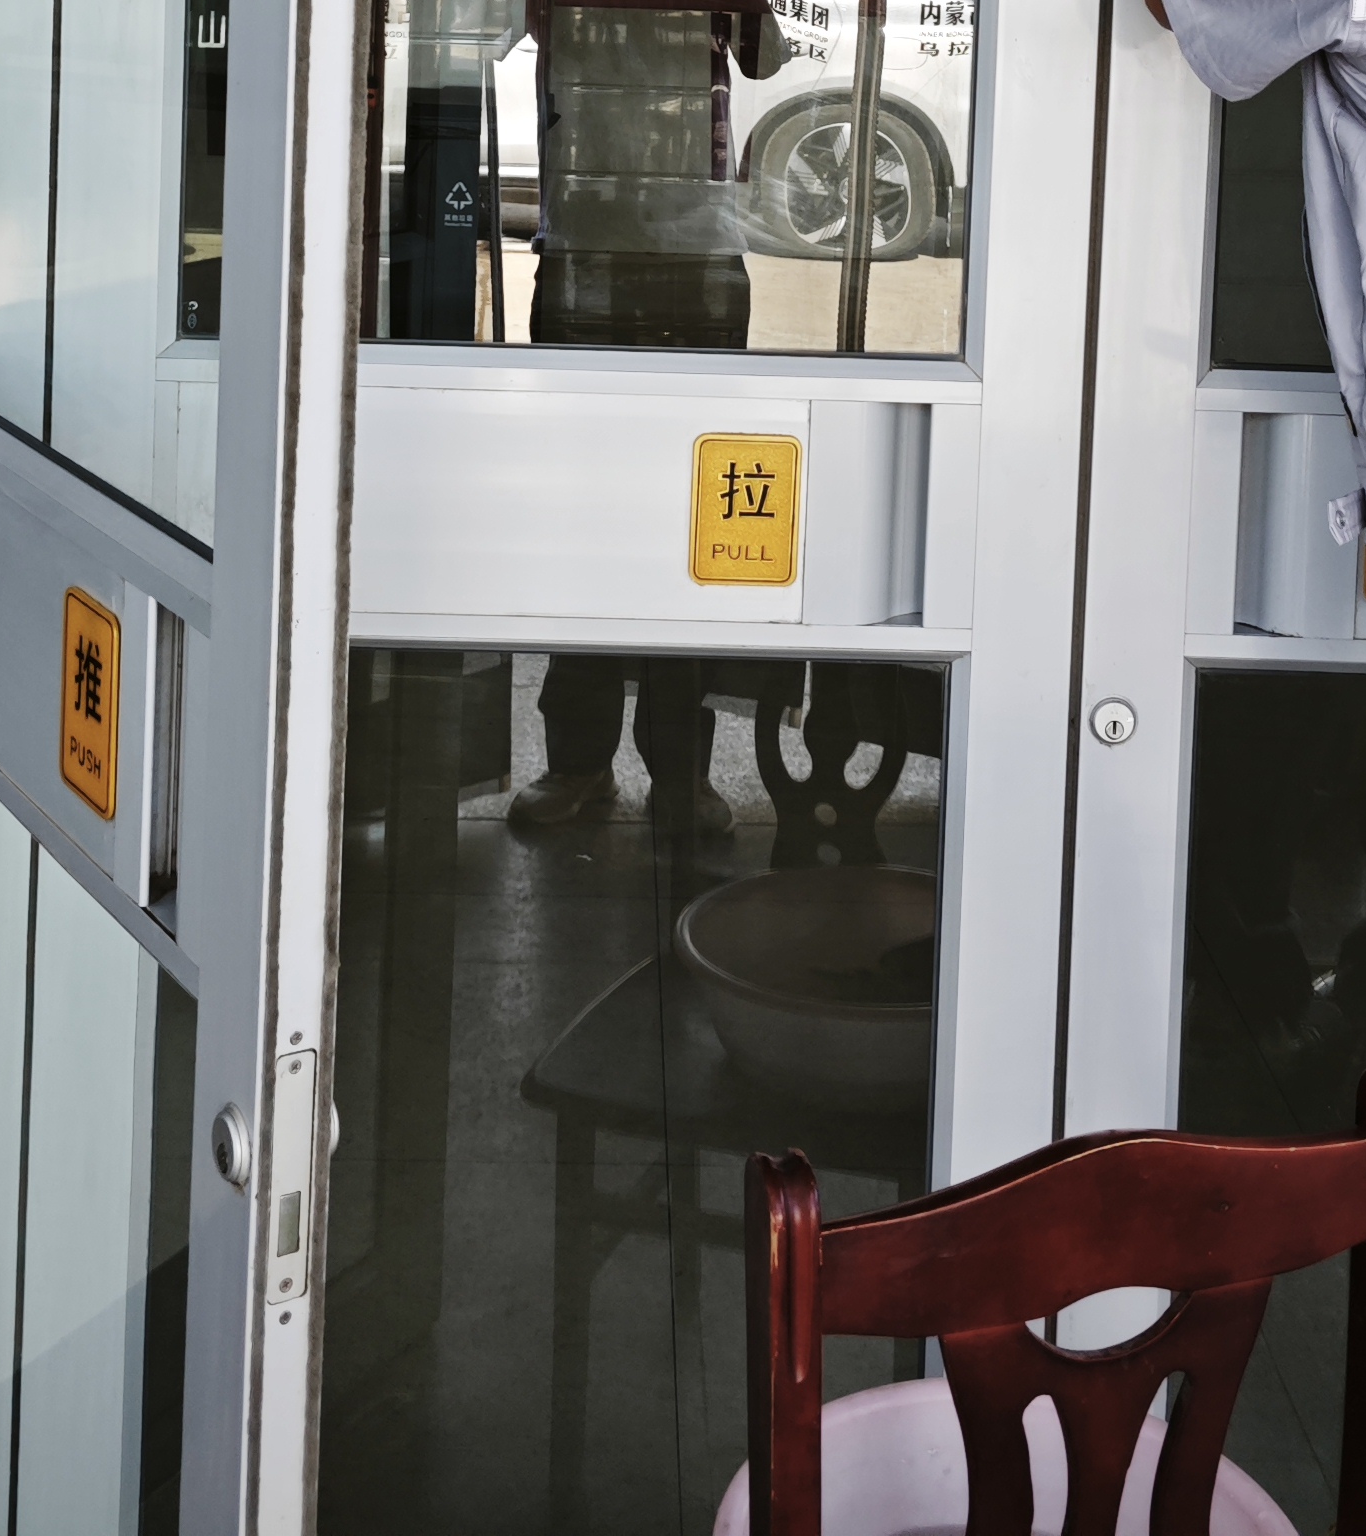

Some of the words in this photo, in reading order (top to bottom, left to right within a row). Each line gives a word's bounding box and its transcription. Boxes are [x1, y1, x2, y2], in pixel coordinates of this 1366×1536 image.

[720, 461, 776, 520] 拉
[711, 543, 773, 562] PULL
[75, 634, 103, 725] 推
[70, 735, 102, 780] PUSH
